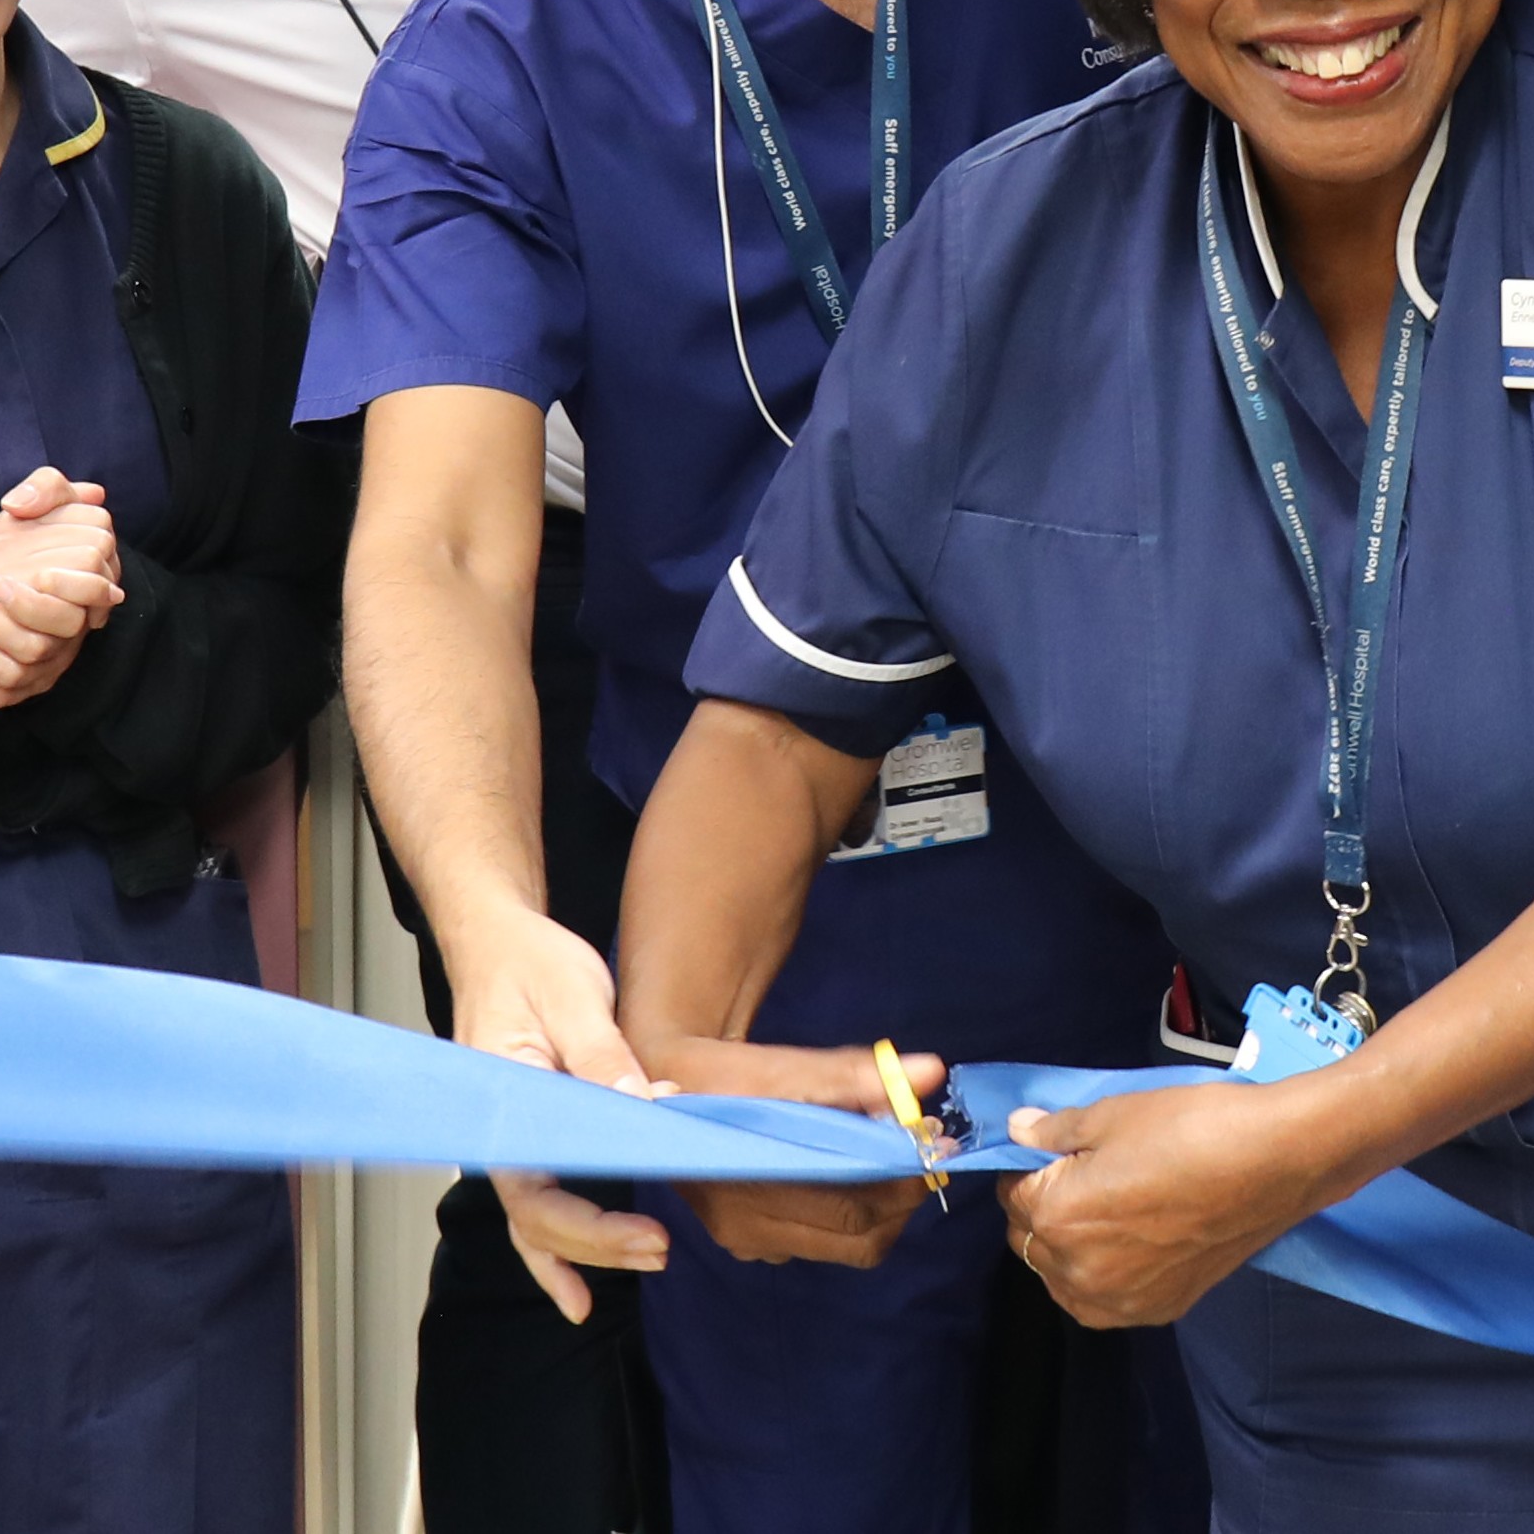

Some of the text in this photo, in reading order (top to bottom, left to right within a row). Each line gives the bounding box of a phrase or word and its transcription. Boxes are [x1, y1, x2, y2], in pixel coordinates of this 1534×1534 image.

[715, 18, 743, 69] tailored
[886, 37, 897, 52] to
[884, 54, 896, 80] you
[736, 70, 764, 123] expertly
[760, 123, 778, 155] care,
[771, 157, 791, 189] class
[883, 118, 898, 239] Staff emergency
[783, 191, 807, 231] World
[811, 264, 846, 331] Hospital
[1210, 255, 1234, 314] expertly
[1224, 315, 1255, 373] tailored
[1244, 373, 1259, 392] to
[1246, 393, 1268, 421] you
[1363, 308, 1415, 584] World class care, expertly tailored to
[1271, 461, 1295, 501] Staff
[1348, 629, 1371, 708] Hospital
